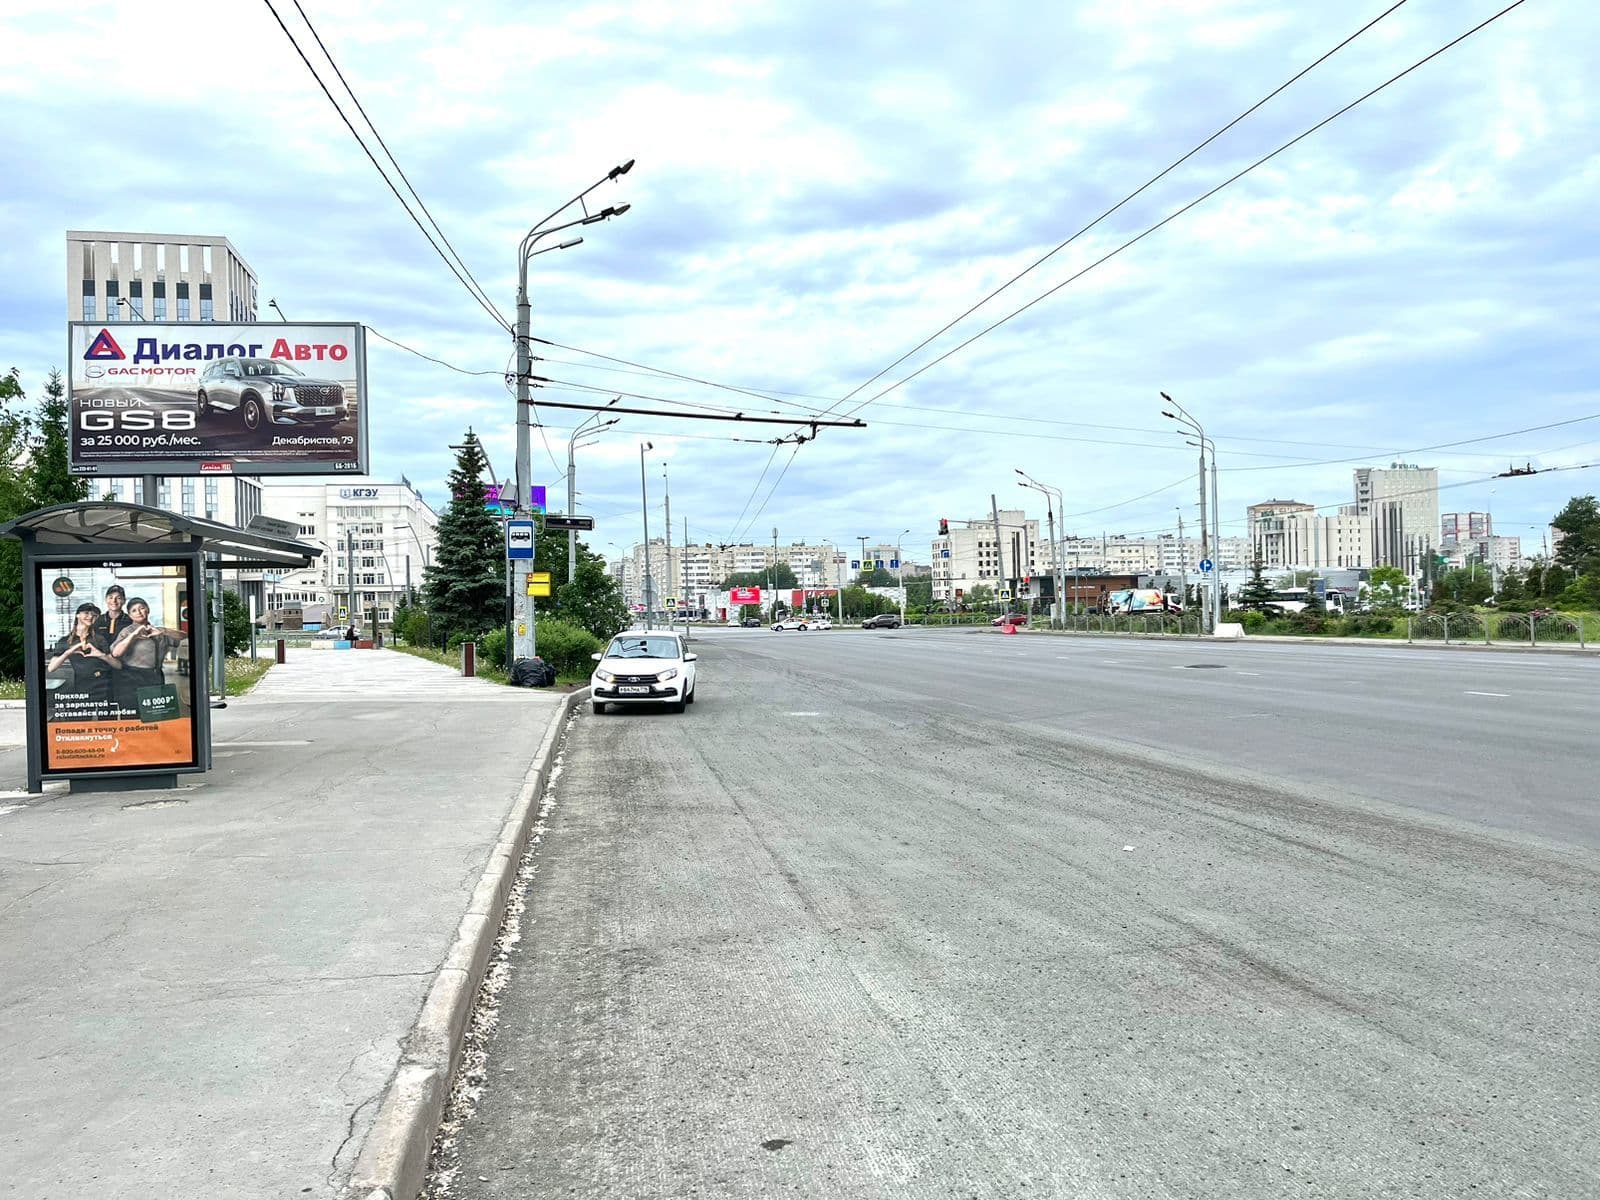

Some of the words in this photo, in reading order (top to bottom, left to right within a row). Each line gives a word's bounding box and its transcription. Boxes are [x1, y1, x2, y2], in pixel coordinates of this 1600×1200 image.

[133, 337, 262, 364] Диалог
[270, 338, 348, 361] Авто
[107, 367, 138, 375] GAC
[141, 367, 196, 375] MOTOR
[80, 409, 196, 431] GS8
[80, 437, 95, 446] за
[97, 435, 112, 446] 25
[114, 435, 140, 446] 000
[142, 433, 201, 447] руб./мес.
[272, 436, 341, 446] Декабристов,
[343, 436, 354, 445] 79
[353, 488, 378, 497] КГЭУ
[65, 700, 108, 709] зарплатой
